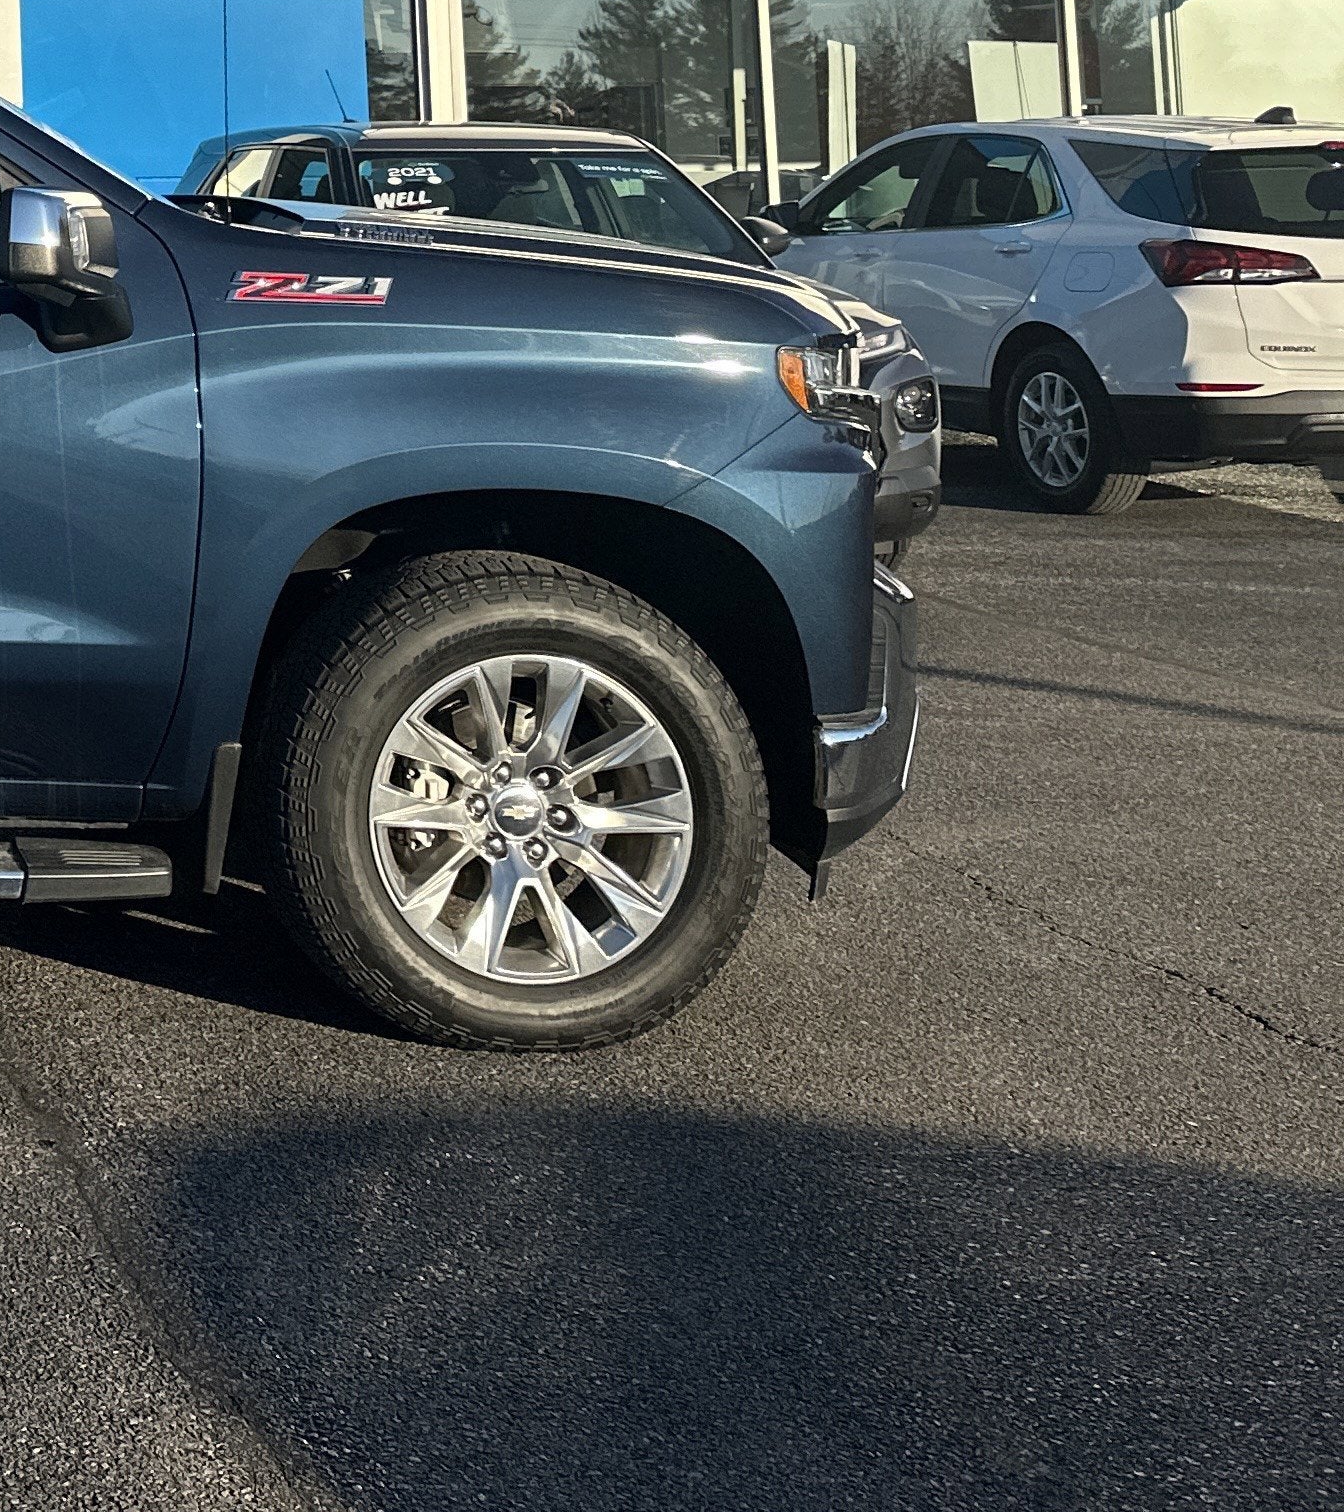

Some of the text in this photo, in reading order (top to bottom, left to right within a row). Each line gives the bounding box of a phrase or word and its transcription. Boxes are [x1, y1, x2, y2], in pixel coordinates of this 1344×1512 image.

[387, 167, 437, 177] 2021
[373, 190, 432, 210] WELL
[224, 270, 394, 306] Z71
